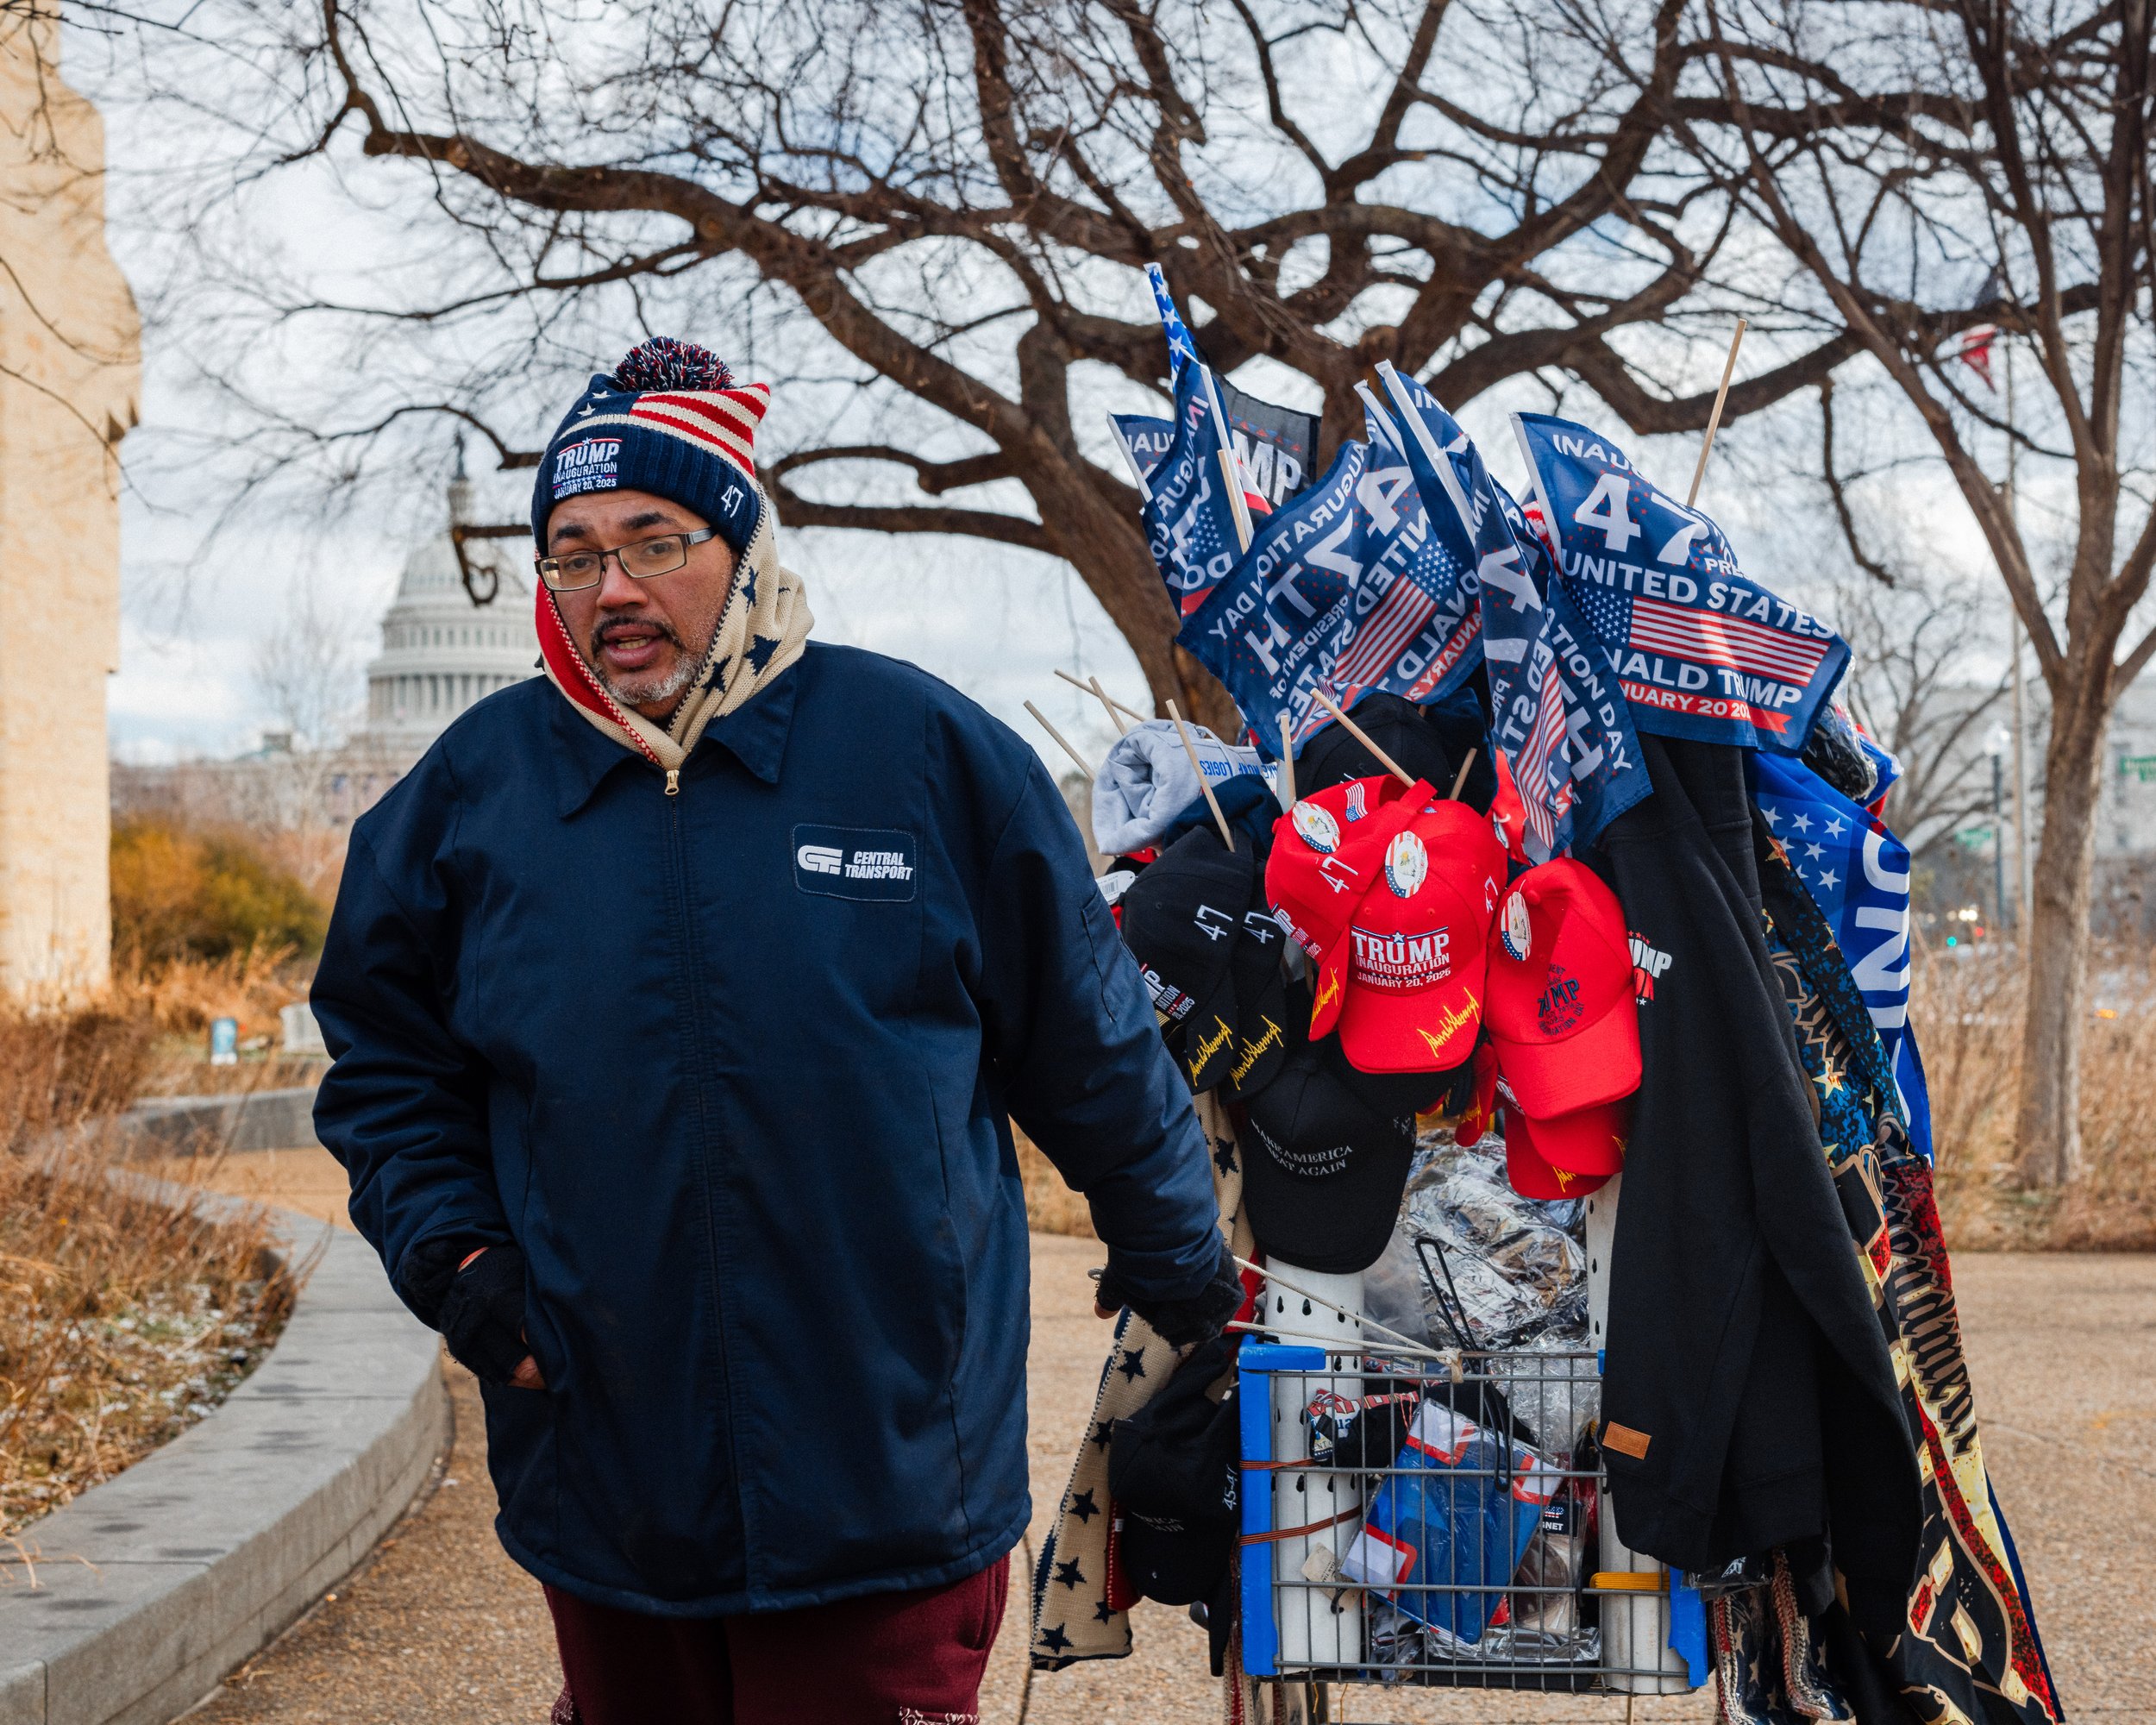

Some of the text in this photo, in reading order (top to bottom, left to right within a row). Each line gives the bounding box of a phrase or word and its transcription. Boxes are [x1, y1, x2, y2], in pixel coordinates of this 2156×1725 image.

[556, 442, 620, 474] TRUMP
[553, 461, 617, 484] INAUGURATION
[555, 482, 581, 499] JANUARY
[596, 479, 617, 488] 2025
[720, 485, 744, 518] 47
[1562, 548, 1698, 604] UNITED
[1707, 581, 1836, 639] STATES
[1717, 668, 1803, 709] TRUMP
[1697, 699, 1728, 717] 20
[1598, 701, 1633, 772] DAY
[853, 850, 905, 866] CENTRAL
[844, 863, 913, 881] TRANSPORT
[1319, 856, 1359, 894] 47
[1194, 904, 1233, 941] 47
[1351, 930, 1450, 965] TRUMP
[1628, 938, 1673, 979] UMP
[1355, 952, 1450, 975] INAUGURATION
[1357, 971, 1402, 988] JANUARY
[1426, 967, 1451, 983] 2025
[1283, 1145, 1353, 1164] AMERICA
[1298, 1158, 1347, 1176] AGAIN
